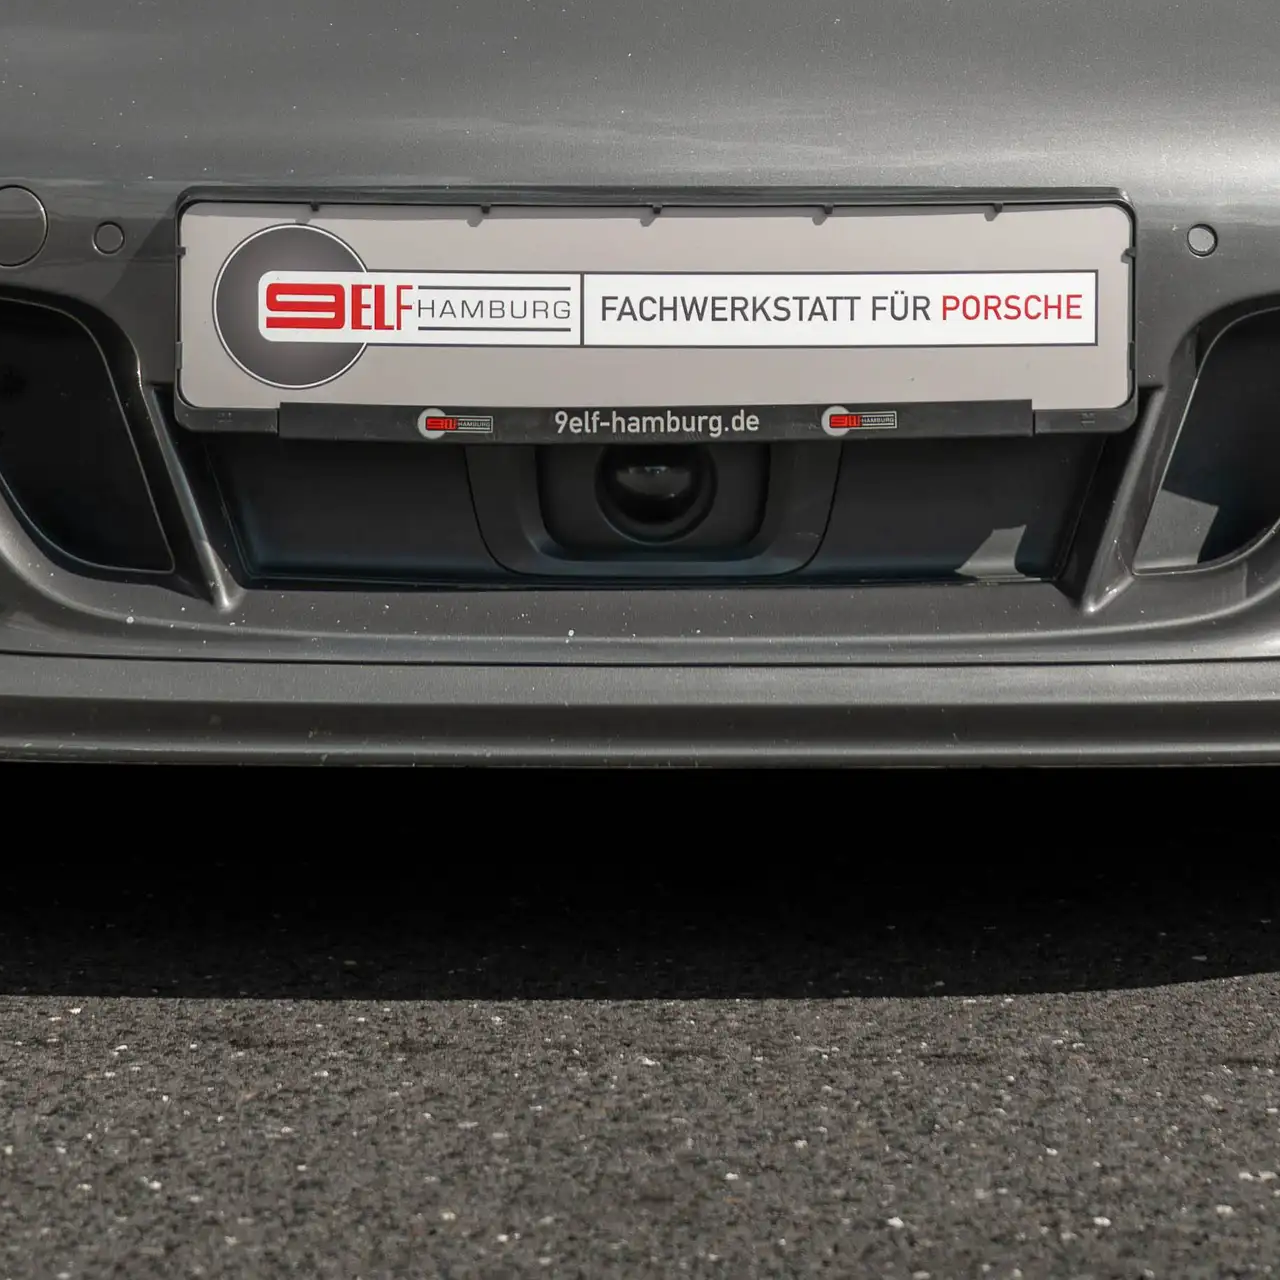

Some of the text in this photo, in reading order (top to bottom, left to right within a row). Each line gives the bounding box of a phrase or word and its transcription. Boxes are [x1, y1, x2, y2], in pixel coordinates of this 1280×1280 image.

[417, 299, 572, 320] HAMBURG
[600, 290, 1083, 322] FACHWERKSTATT FÜR PORSCHE
[554, 408, 760, 438] 9elf-hamburg.de
[861, 416, 895, 424] HAMBURG
